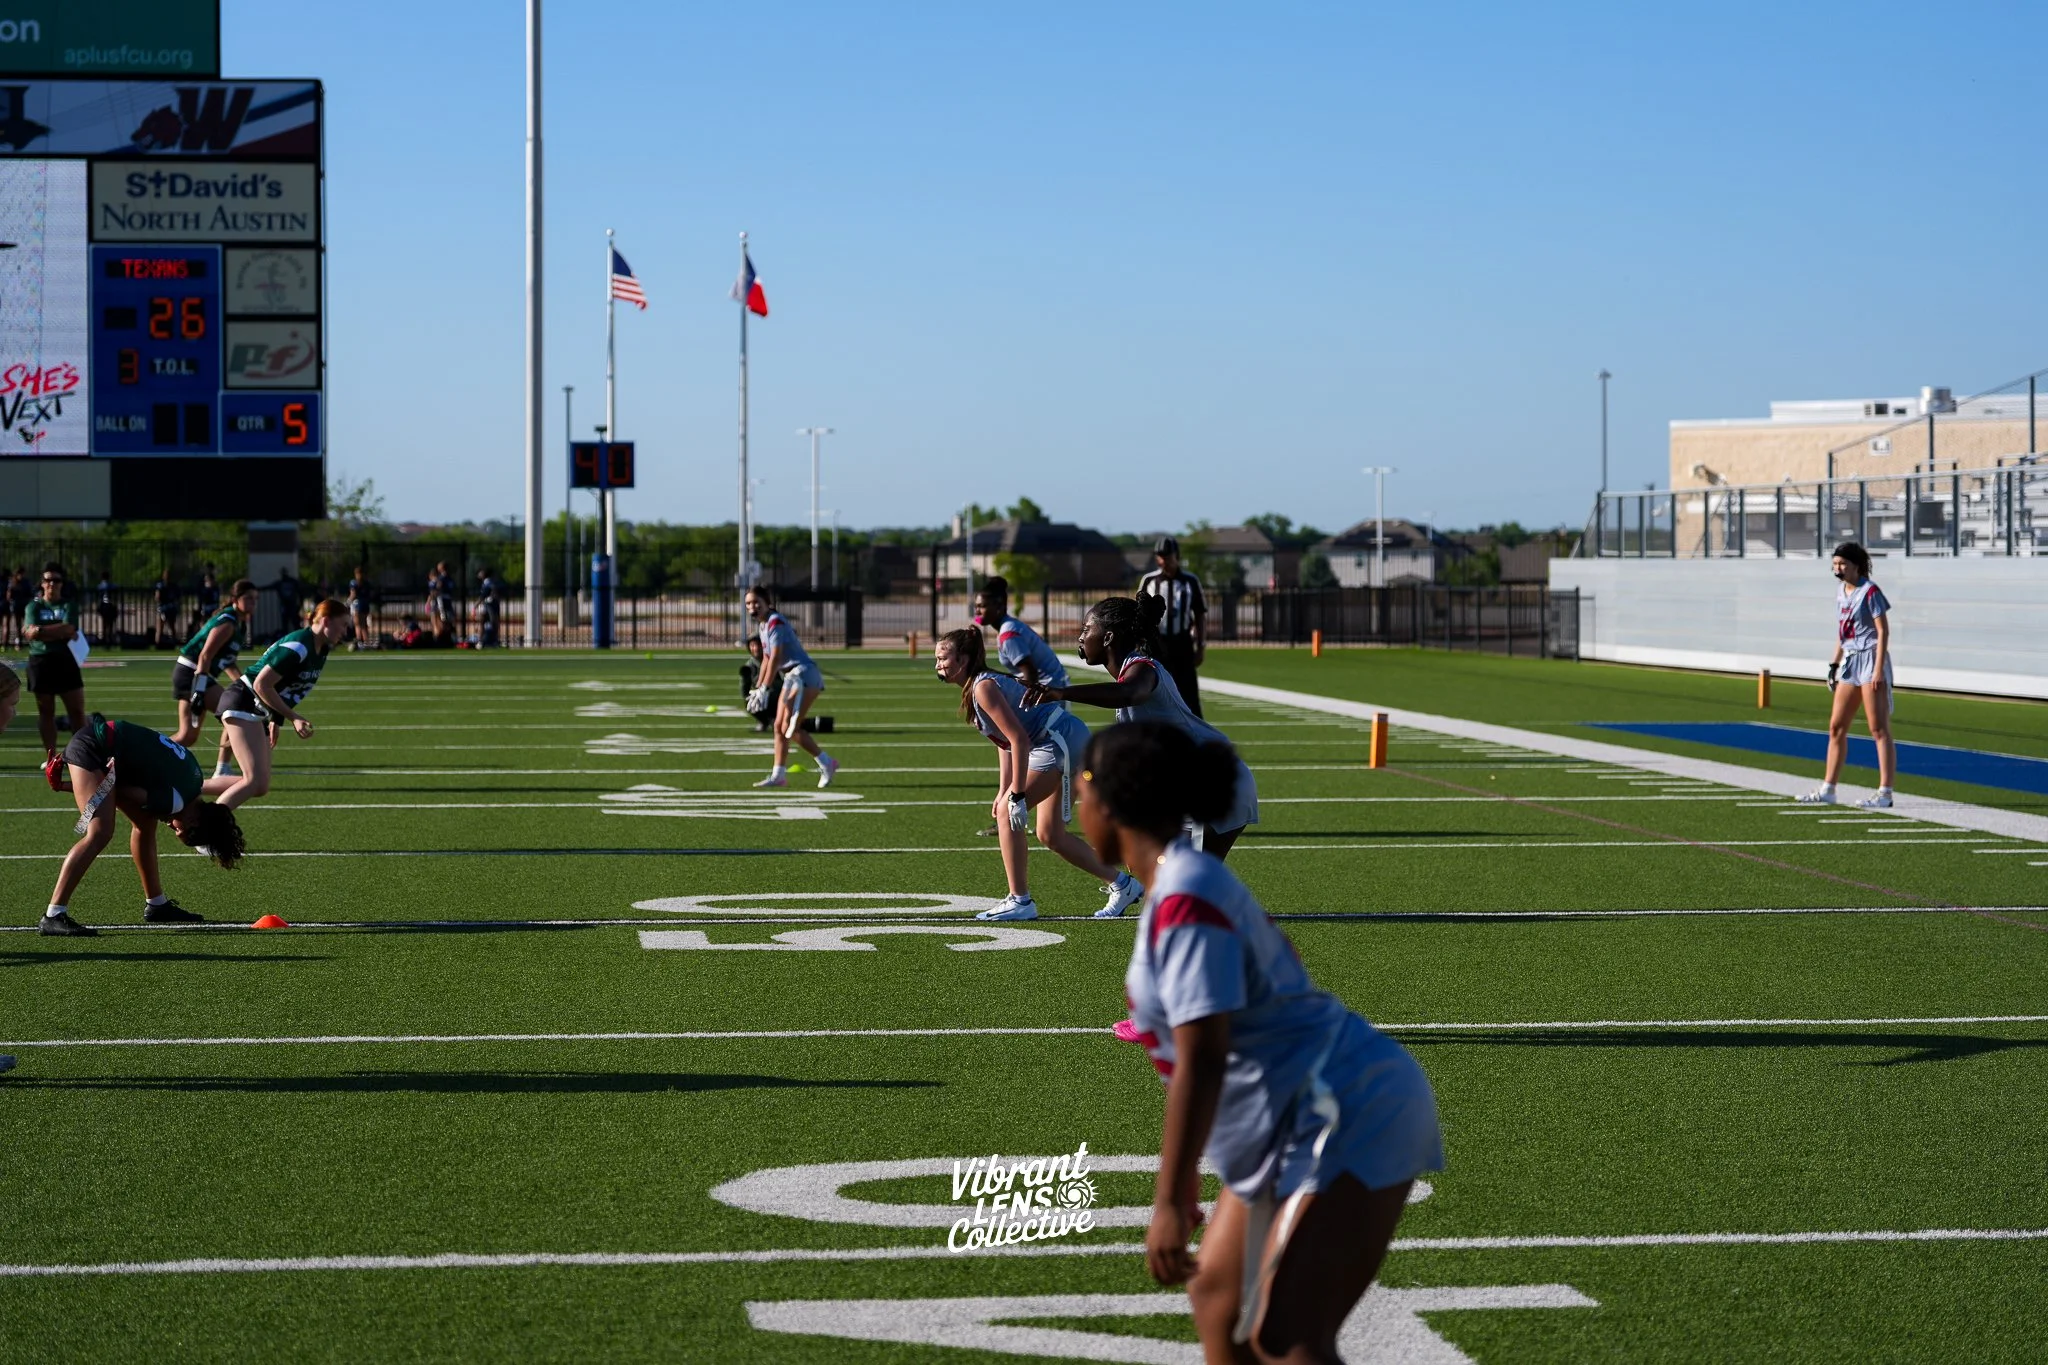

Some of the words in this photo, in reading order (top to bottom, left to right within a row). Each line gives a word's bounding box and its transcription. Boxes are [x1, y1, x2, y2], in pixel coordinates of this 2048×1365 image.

[64, 46, 193, 68] aplusfcu.org
[101, 203, 201, 231] NORTH
[208, 204, 308, 232] AUSTIN
[121, 259, 190, 279] TEXANS
[149, 297, 206, 339] 26
[0, 362, 80, 395] SHE'S
[119, 349, 140, 384] 3
[153, 357, 195, 375] T.O.L.
[96, 415, 126, 431] BALL
[128, 415, 147, 431] ON
[236, 415, 266, 431] QTR
[283, 404, 308, 445] 5
[575, 445, 632, 484] 40
[632, 891, 1069, 953] 50
